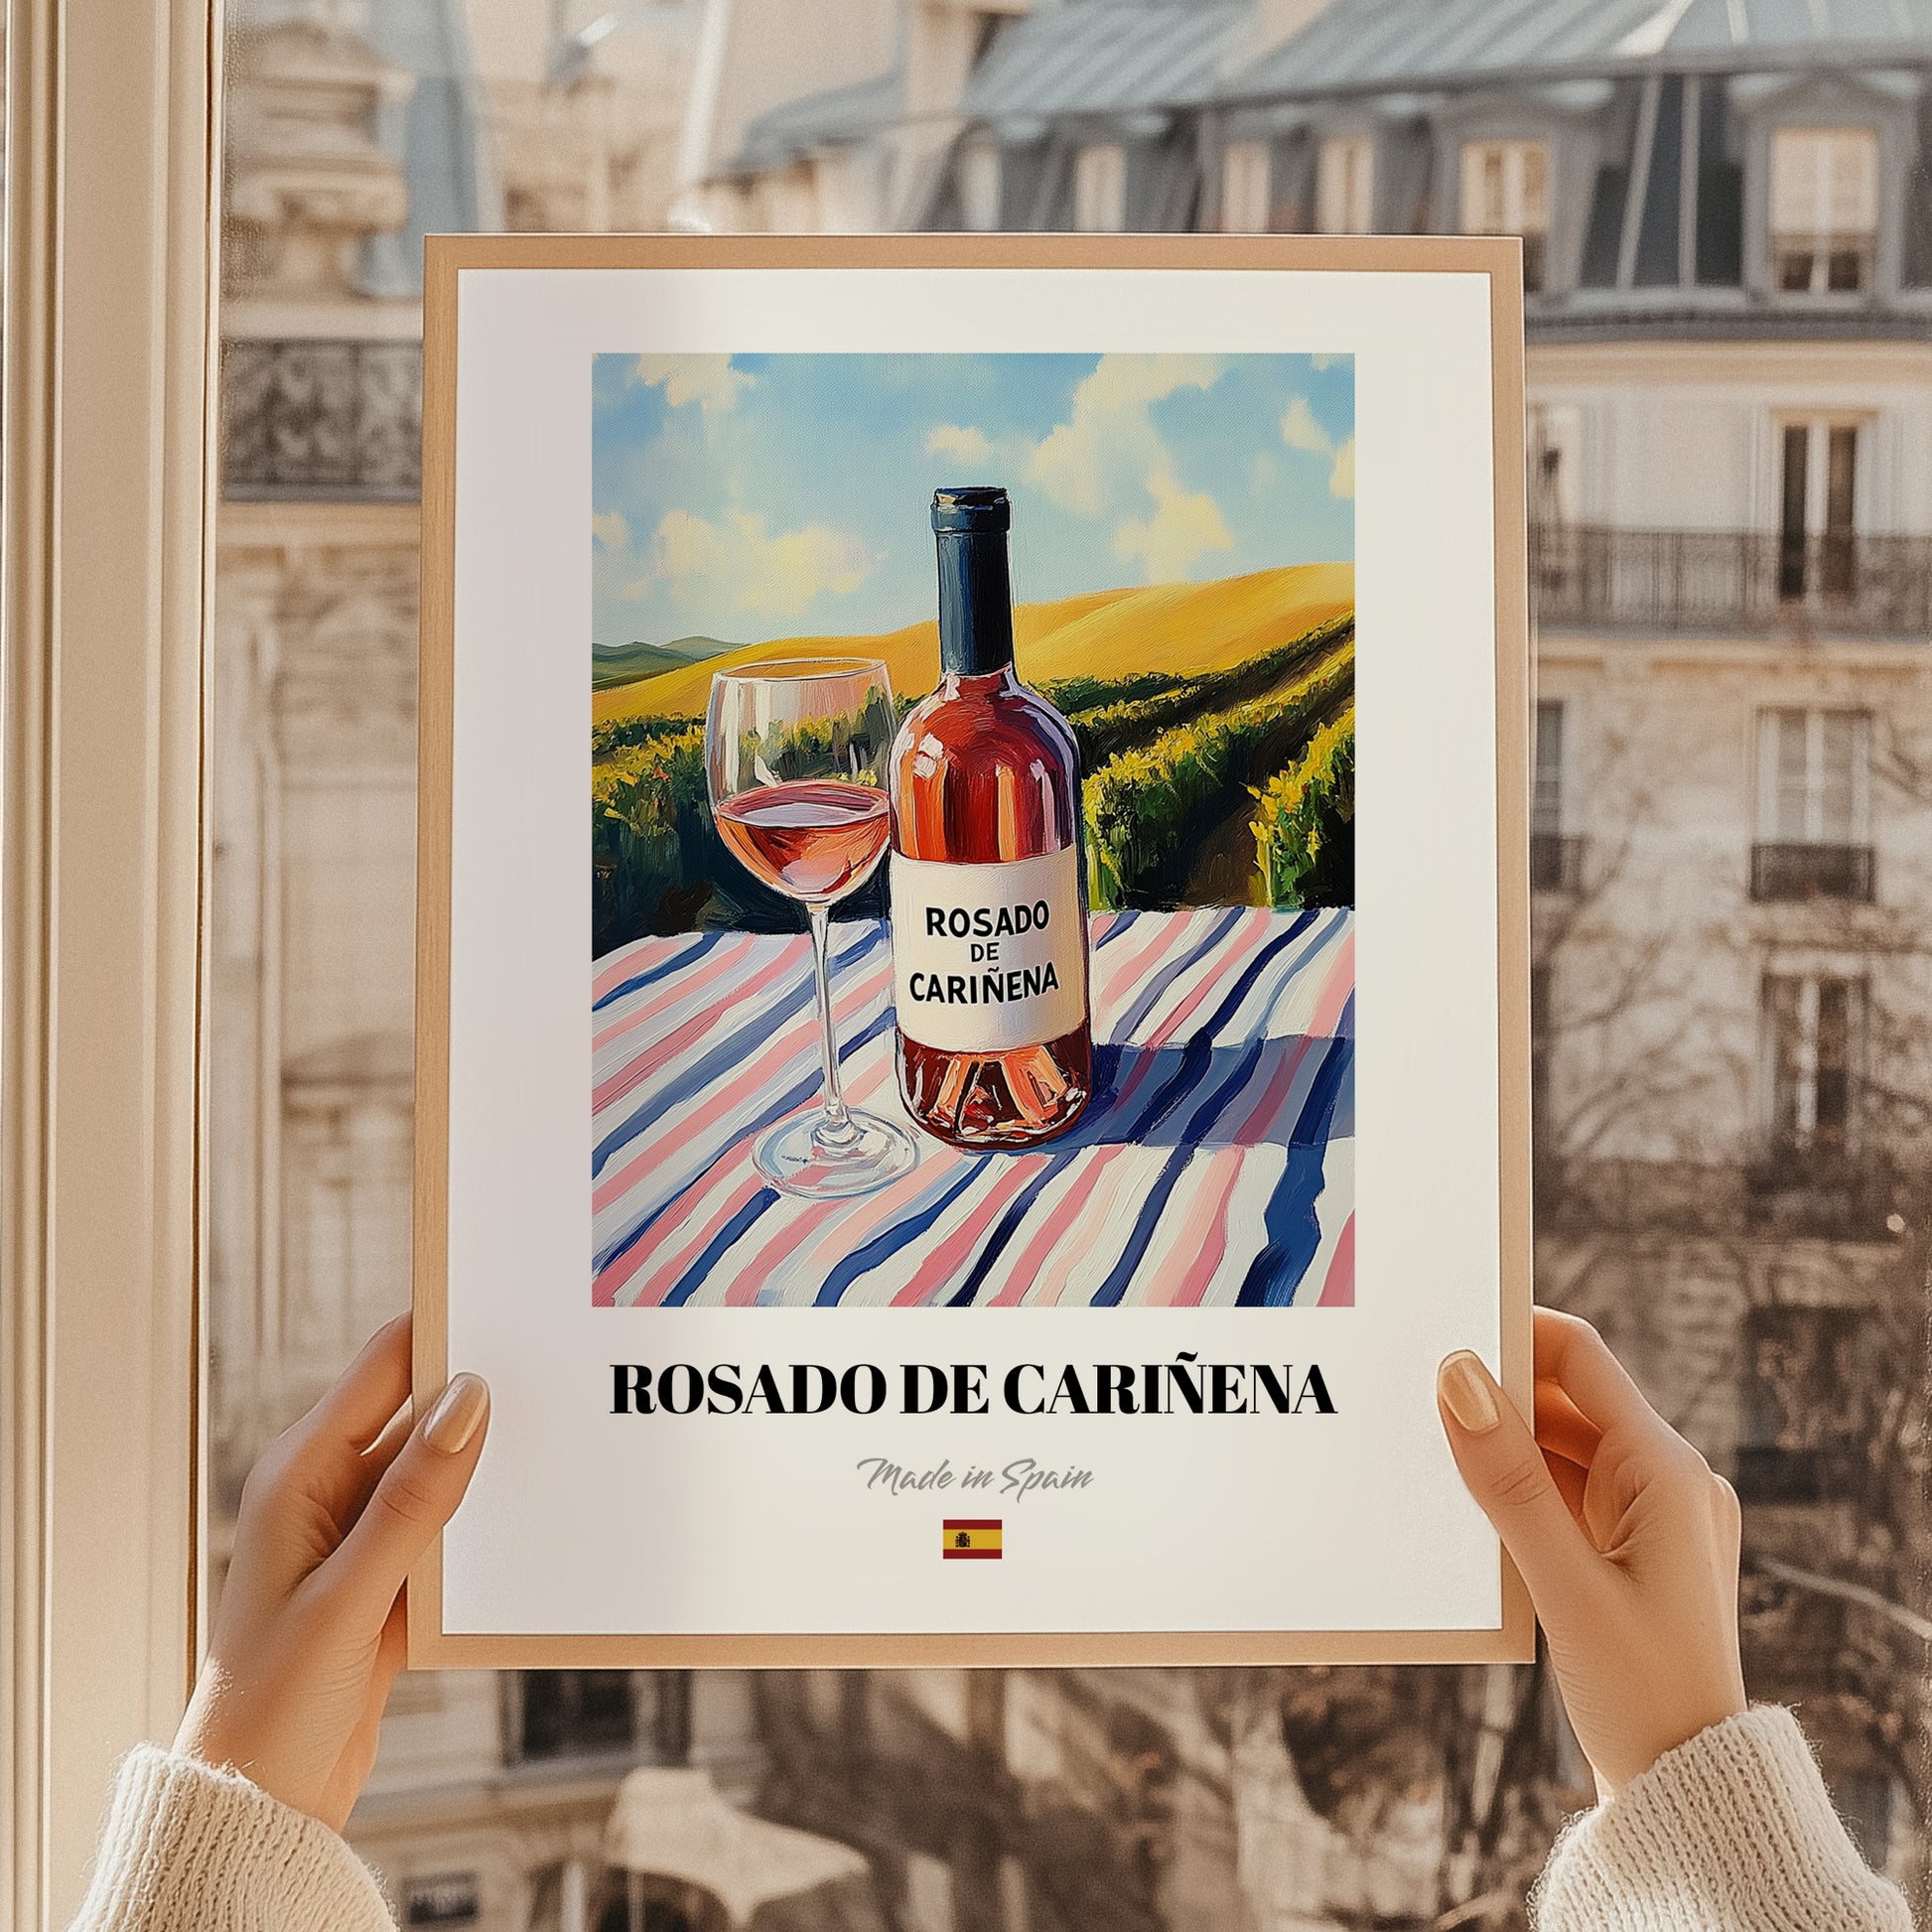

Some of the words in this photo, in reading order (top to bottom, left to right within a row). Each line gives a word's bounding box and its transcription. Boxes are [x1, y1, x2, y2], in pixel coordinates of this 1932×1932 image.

[925, 900, 1050, 937] ROSADO
[970, 942, 1000, 962] DE
[909, 961, 1059, 1005] CARIÑENA
[610, 1363, 888, 1415] ROSADO
[899, 1364, 990, 1415] DE
[1003, 1351, 1339, 1415] CARIÑENA
[856, 1457, 957, 1497] Made
[960, 1464, 996, 1491] in
[999, 1457, 1095, 1504] Spain
